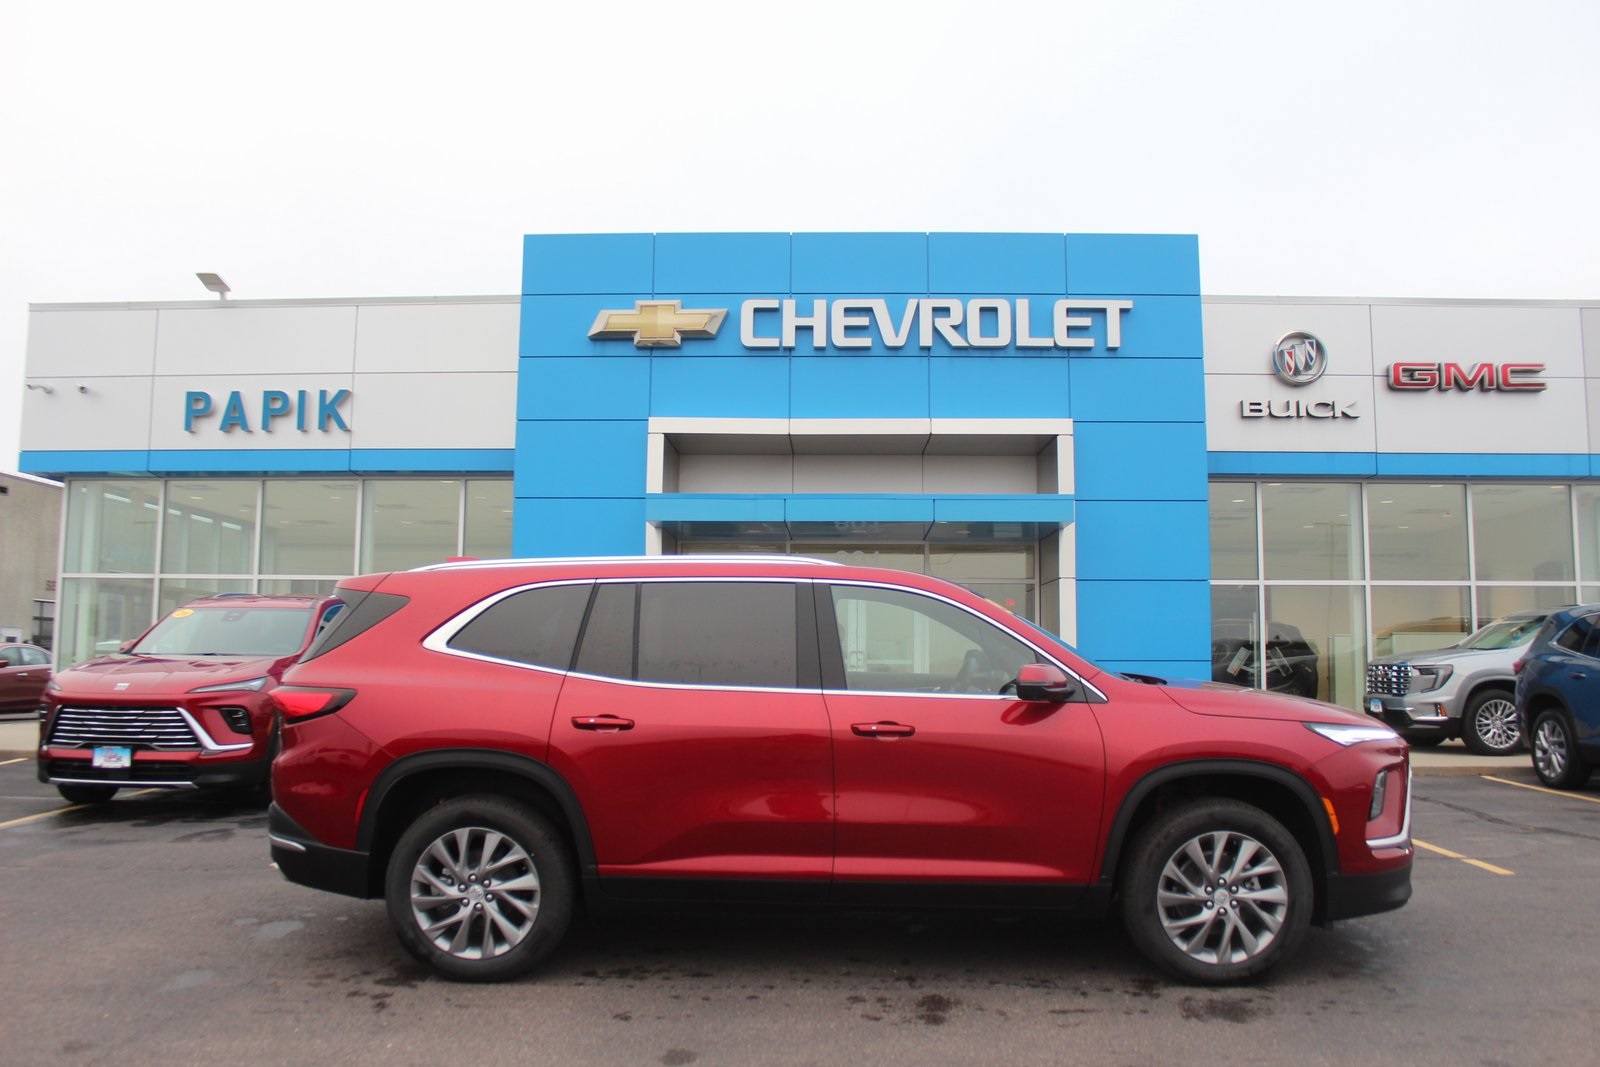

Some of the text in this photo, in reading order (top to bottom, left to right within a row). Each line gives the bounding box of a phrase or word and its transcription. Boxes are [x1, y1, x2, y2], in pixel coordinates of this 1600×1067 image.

[739, 298, 1133, 349] CHEVROLET
[1387, 362, 1547, 392] GMC
[185, 389, 351, 432] PAPIK
[1240, 399, 1360, 418] BUICK
